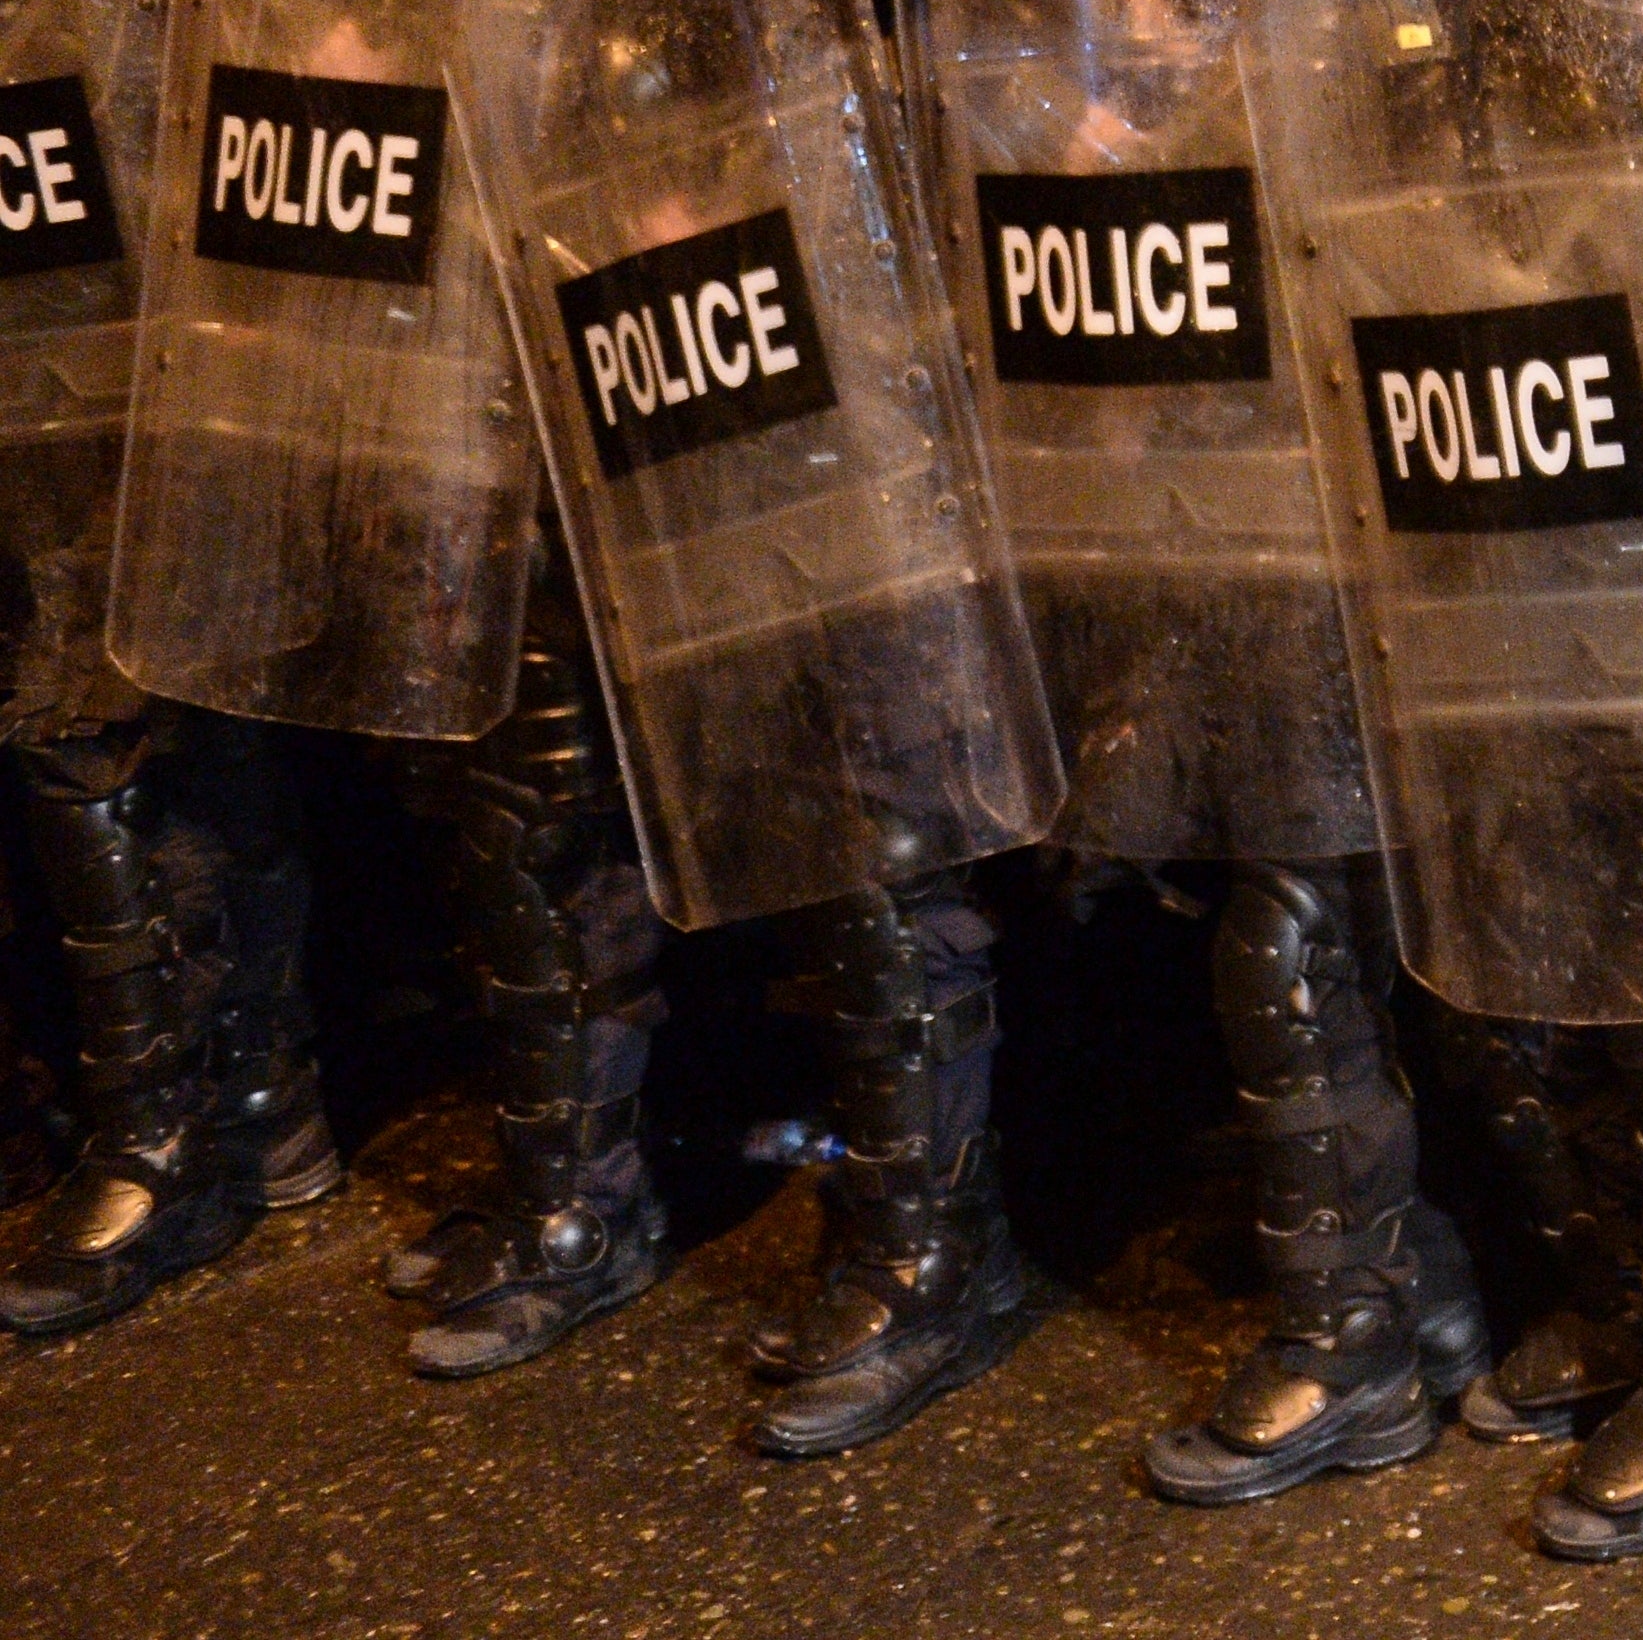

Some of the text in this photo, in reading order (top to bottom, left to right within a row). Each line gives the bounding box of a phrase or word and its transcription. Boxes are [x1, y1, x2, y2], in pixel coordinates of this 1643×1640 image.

[215, 115, 419, 237] POLICE
[1001, 222, 1238, 336] POLICE
[584, 266, 800, 426] POLICE
[1381, 355, 1626, 482] POLICE
